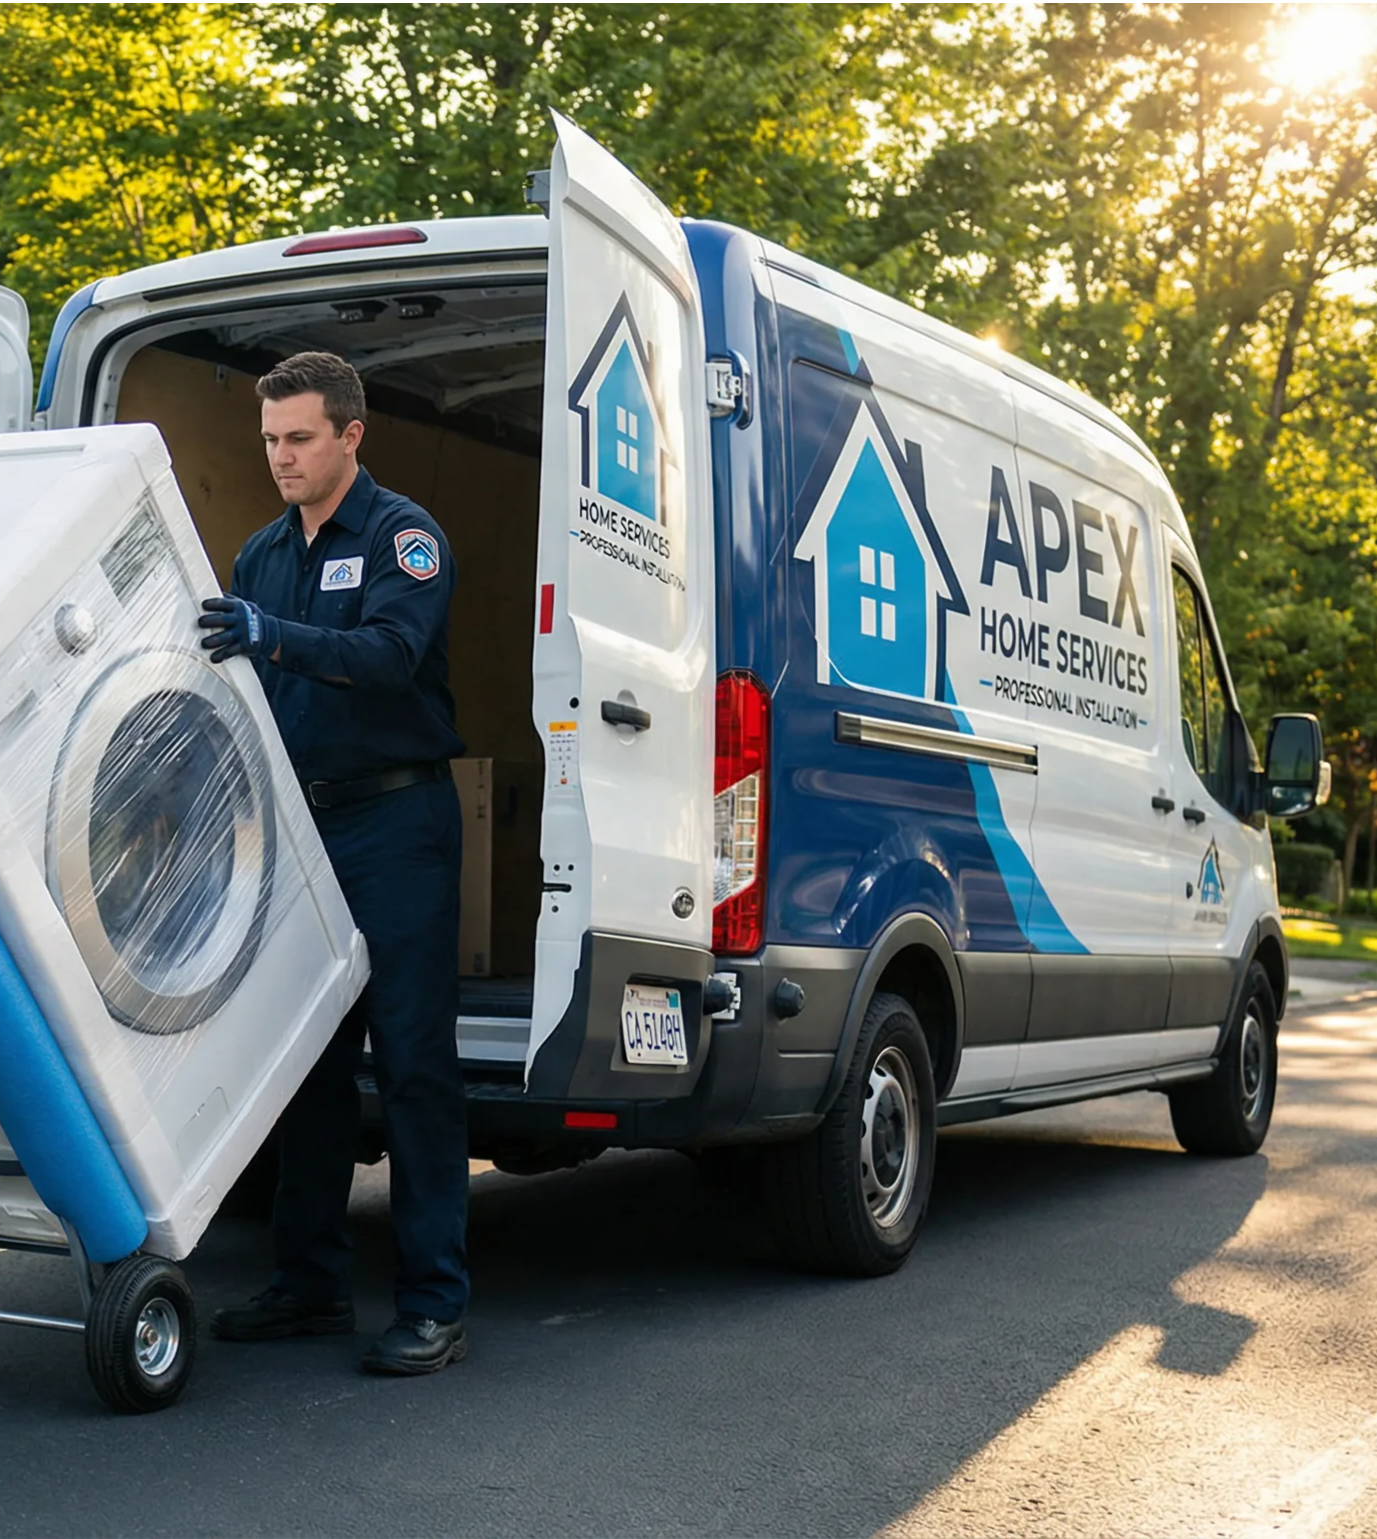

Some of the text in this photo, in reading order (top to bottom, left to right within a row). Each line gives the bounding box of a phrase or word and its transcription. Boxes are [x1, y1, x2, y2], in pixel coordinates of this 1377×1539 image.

[579, 496, 671, 560] HOME SERVICES
[979, 464, 1146, 638] APEX
[980, 605, 1148, 696] HOME SERVICES
[994, 674, 1138, 730] PROFESSIONAL INSTALLATION
[625, 1010, 643, 1050] CA
